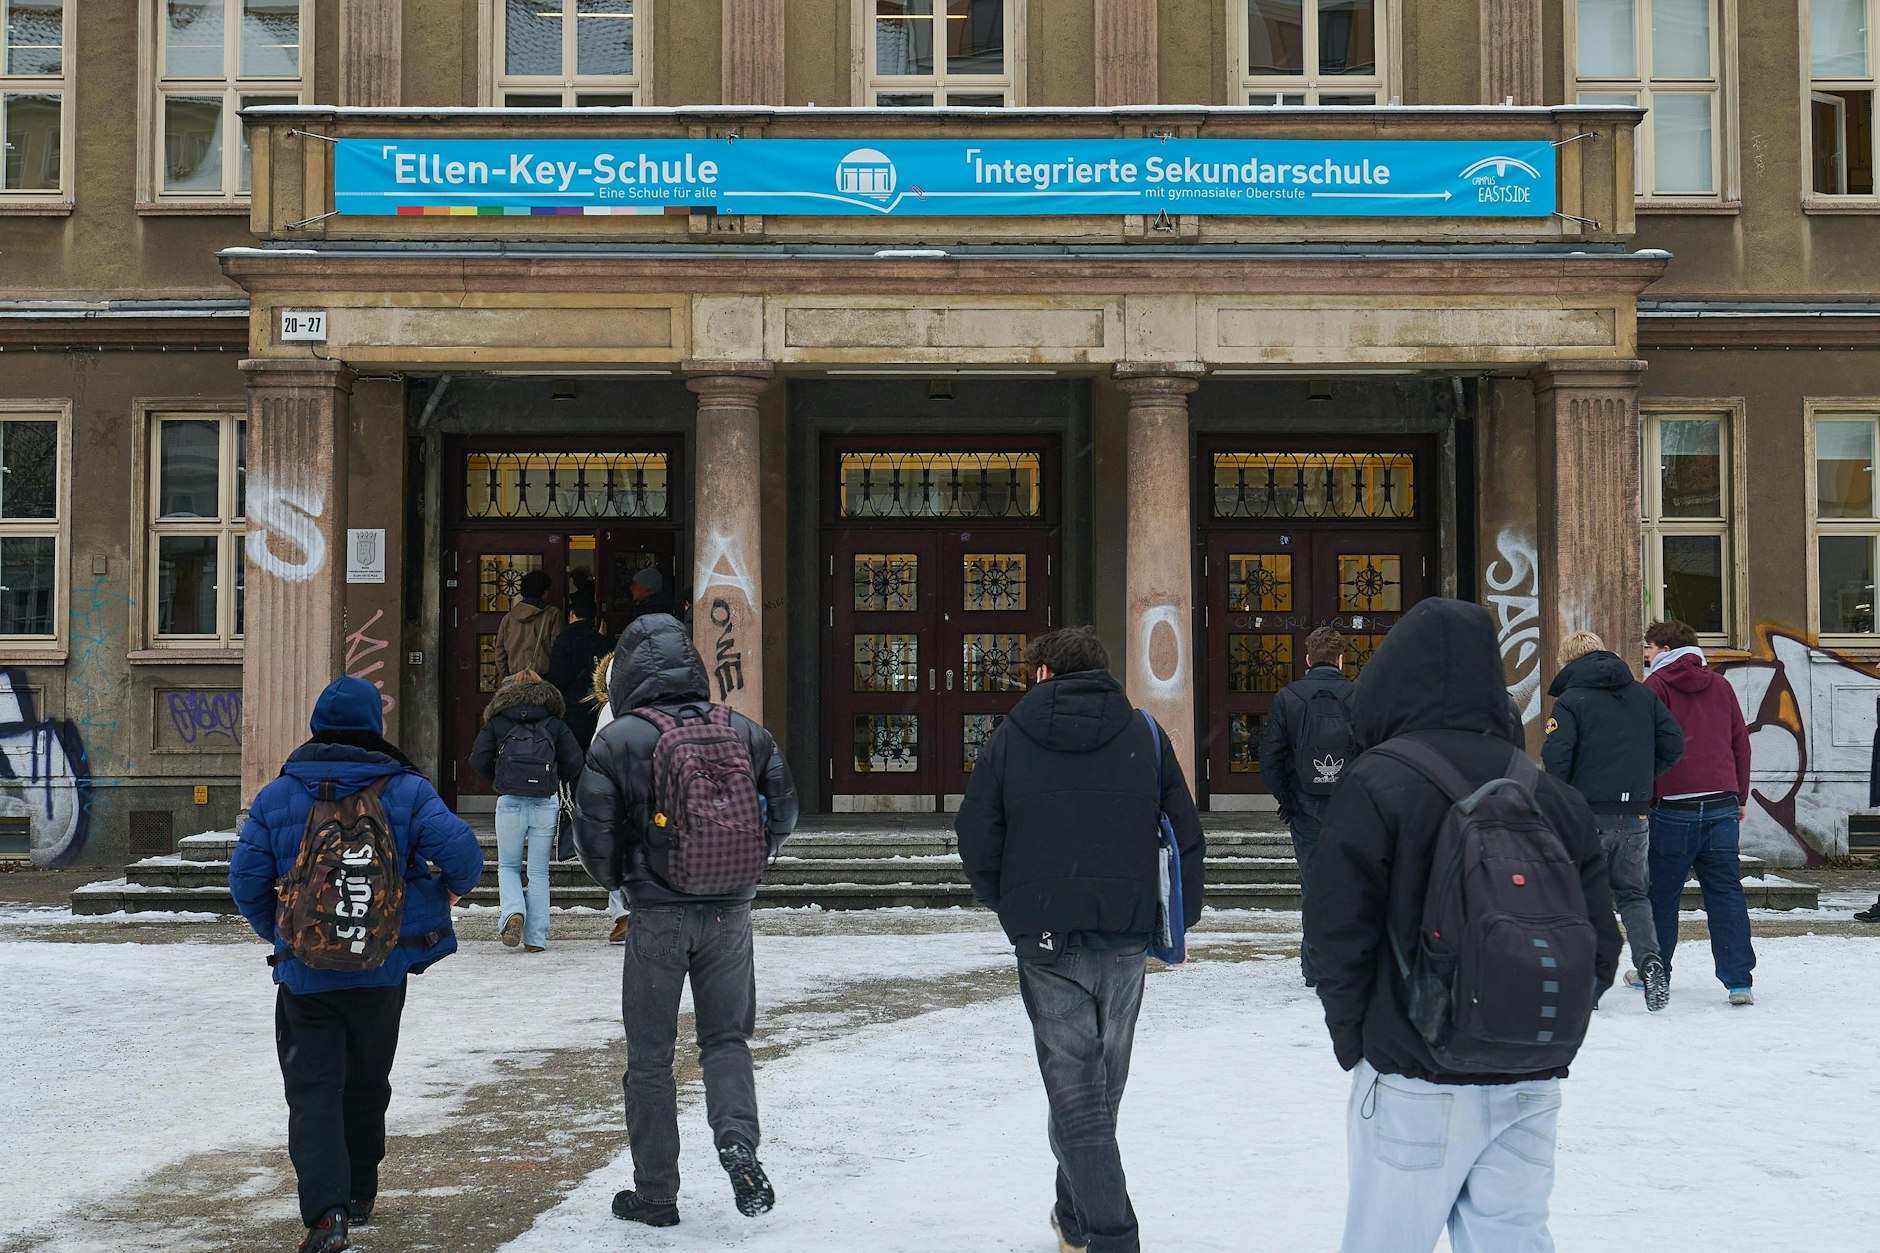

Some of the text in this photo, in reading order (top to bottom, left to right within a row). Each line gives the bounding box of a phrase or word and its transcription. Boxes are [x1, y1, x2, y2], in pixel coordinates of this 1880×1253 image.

[395, 153, 718, 191] Ellen-Key-Schule
[975, 156, 1391, 190] Integrierte Sekundarschule
[1471, 175, 1496, 186] CAMPUS
[599, 187, 718, 198] Eine Schule für alle
[1145, 187, 1306, 200] mit gymnasialer Oberstufe
[1478, 185, 1531, 203] EASTSIDE
[284, 317, 321, 333] 20-27
